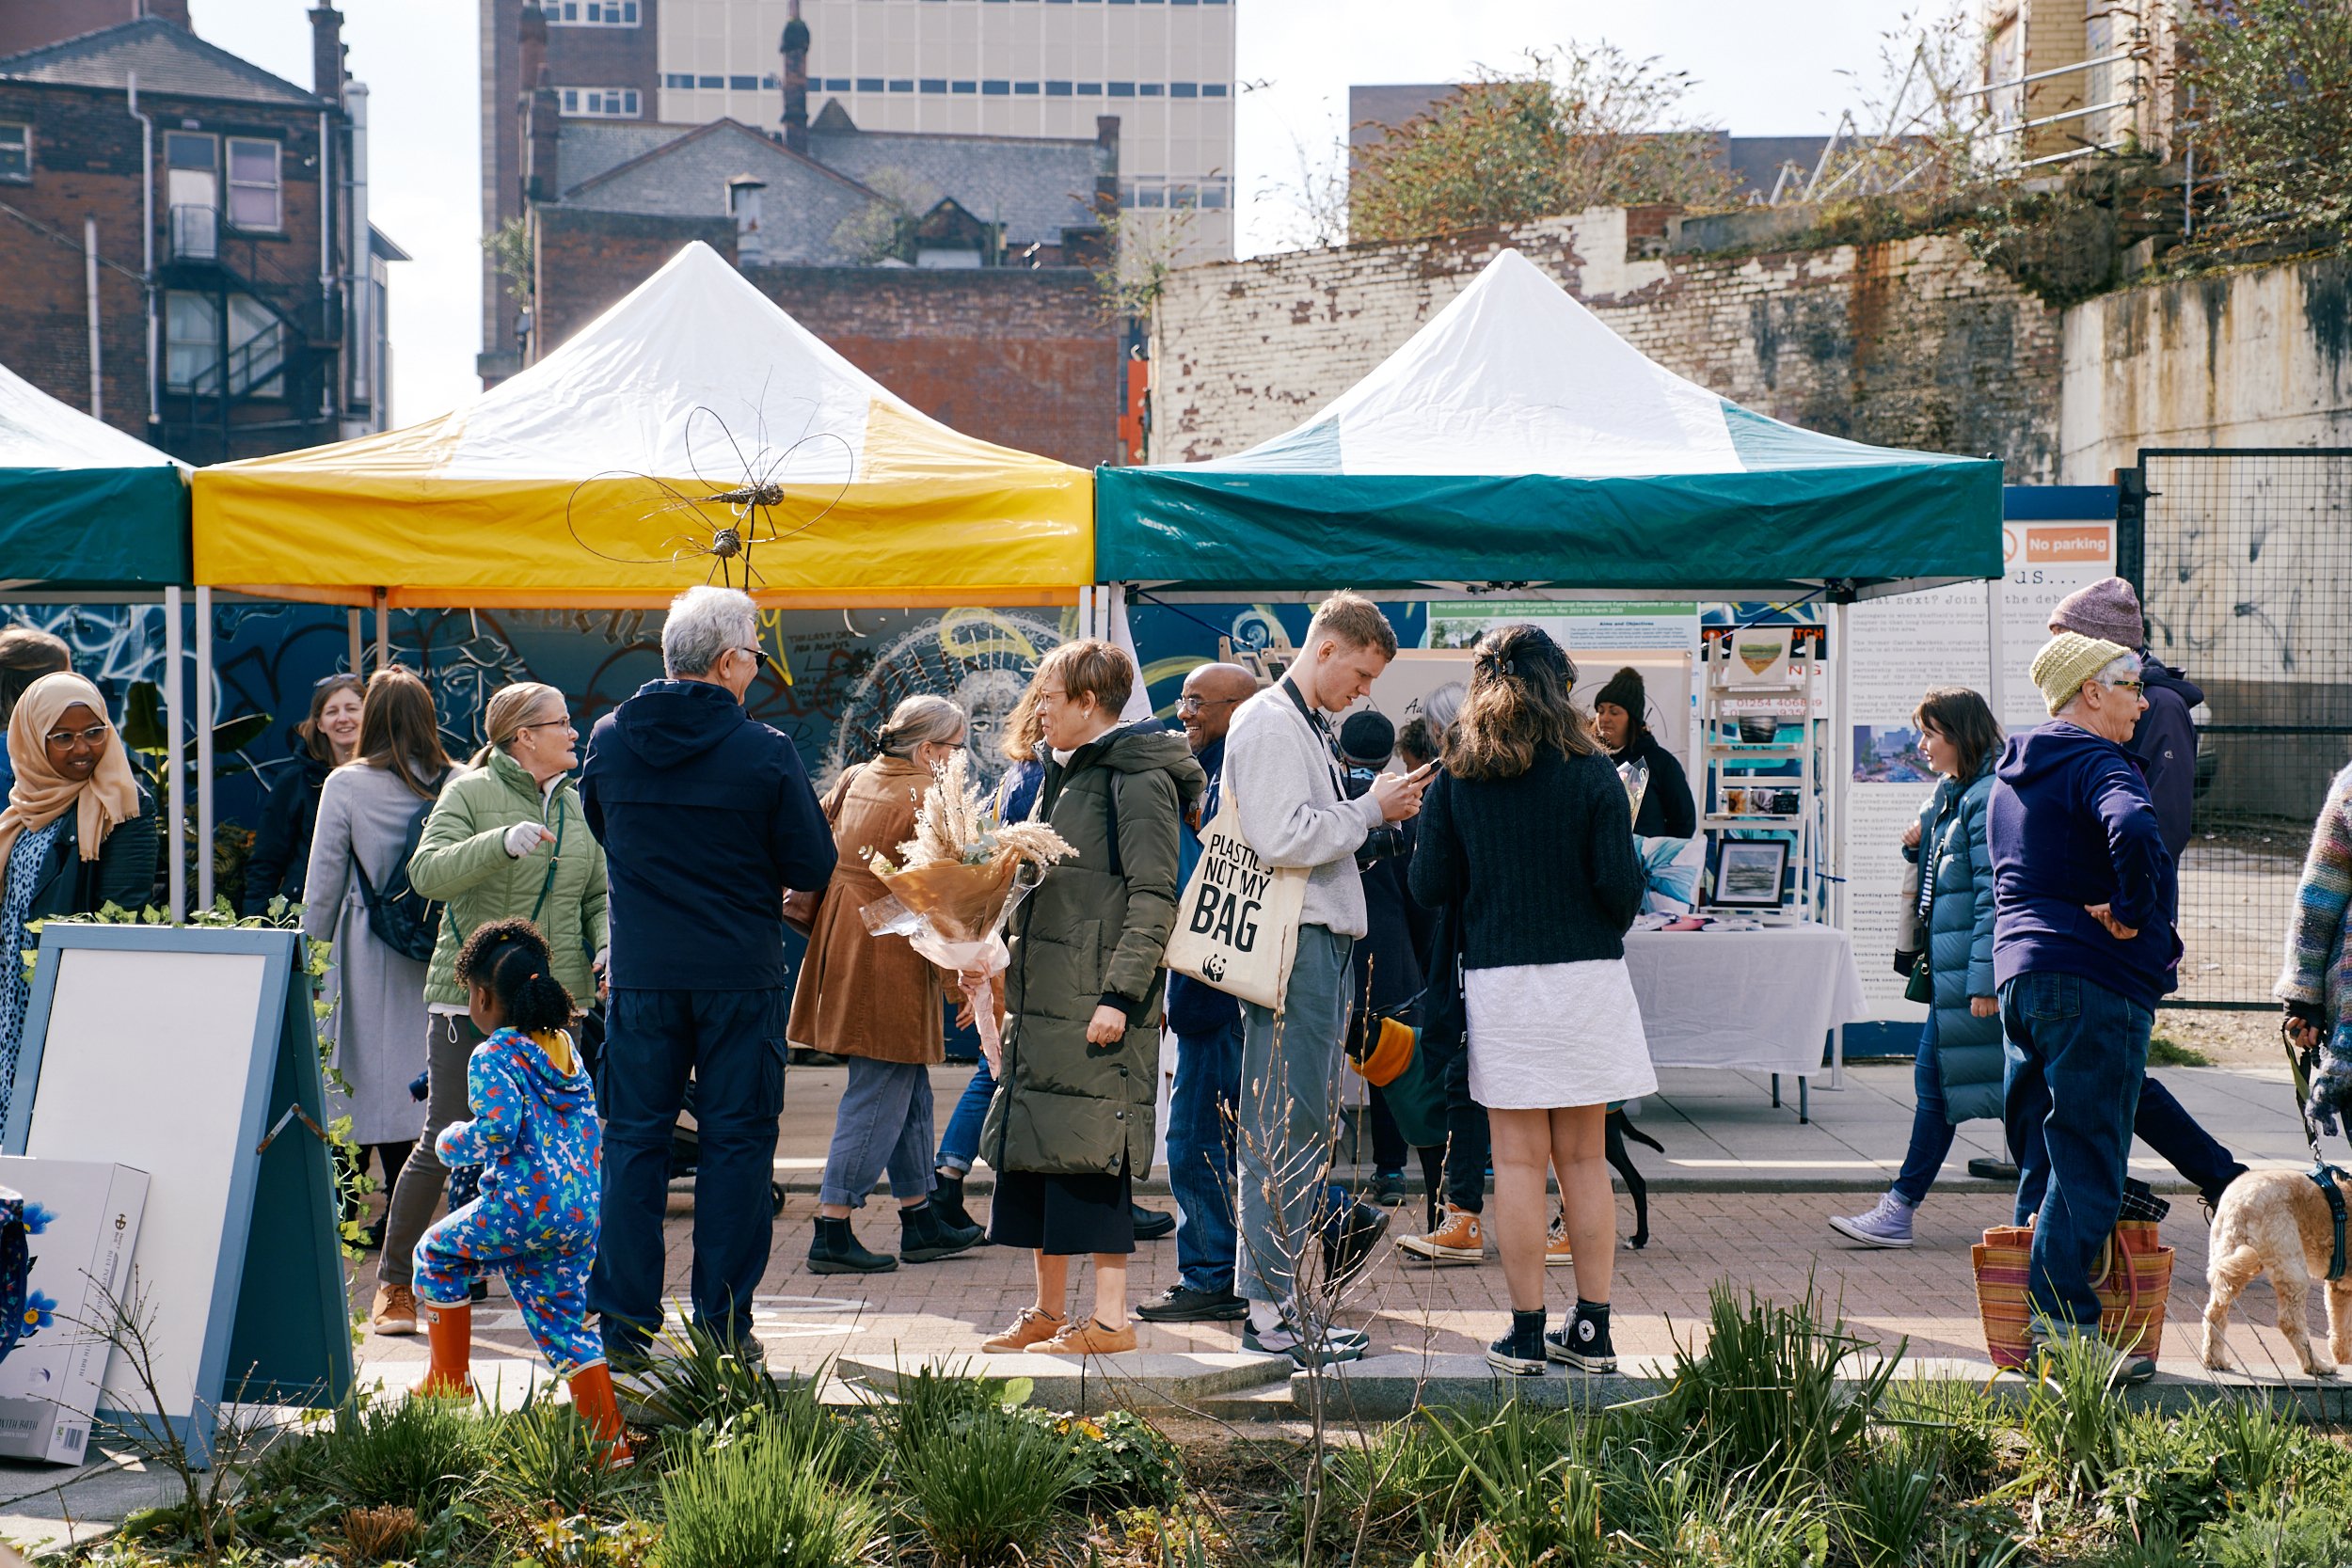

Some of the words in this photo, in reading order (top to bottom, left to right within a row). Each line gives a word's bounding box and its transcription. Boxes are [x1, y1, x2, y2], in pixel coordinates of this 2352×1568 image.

[2029, 537, 2050, 551] No
[2053, 536, 2107, 553] parking
[1897, 594, 1939, 605] next?
[1946, 594, 1978, 605] Join
[2006, 594, 2028, 605] the
[1737, 699, 1772, 707] 01254
[1777, 699, 1822, 707] 40689
[1203, 856, 1239, 889] NOT
[1239, 869, 1271, 900] MY
[1189, 882, 1262, 953] BAG
[19, 1419, 39, 1431] BATH
